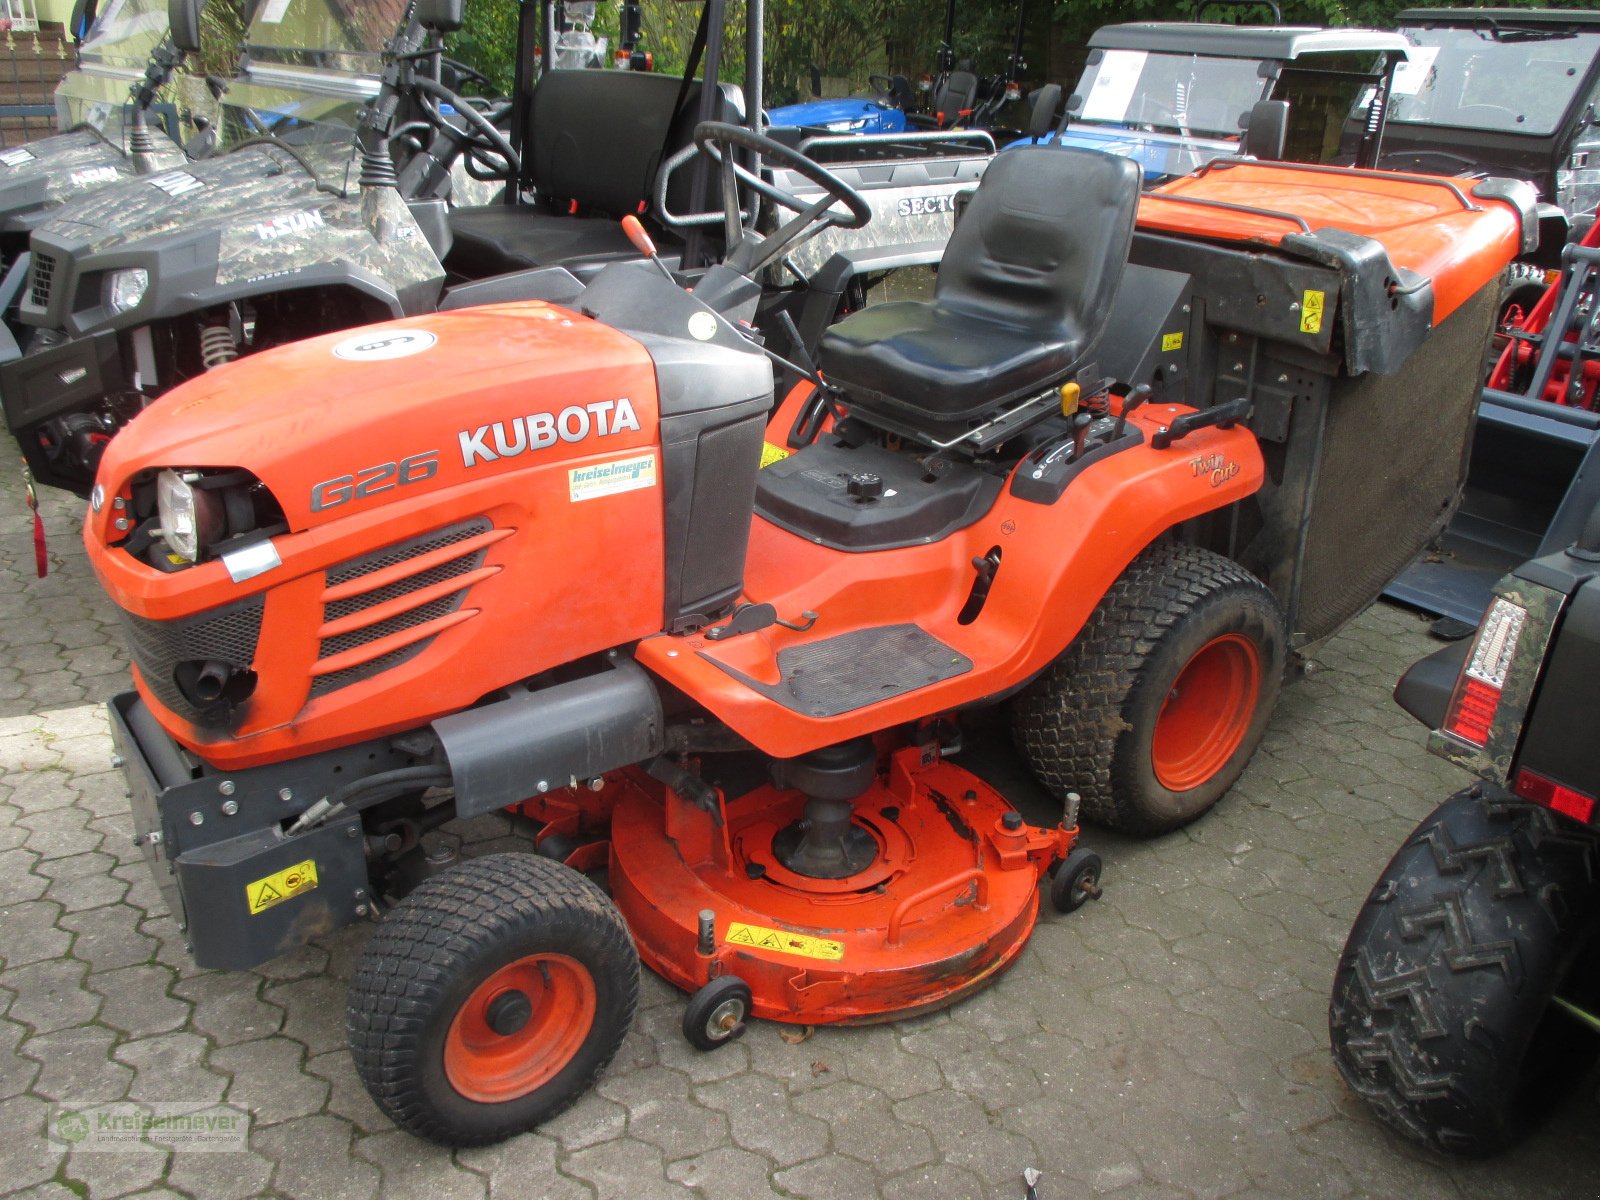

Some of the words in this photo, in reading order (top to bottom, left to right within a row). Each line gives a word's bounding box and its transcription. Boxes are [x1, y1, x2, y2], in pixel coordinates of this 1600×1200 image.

[457, 397, 642, 468] KUBOTA
[572, 459, 654, 483] kreiselmeyer
[1188, 454, 1225, 478] Twin
[1210, 461, 1241, 488] Cut
[309, 448, 440, 513] G26
